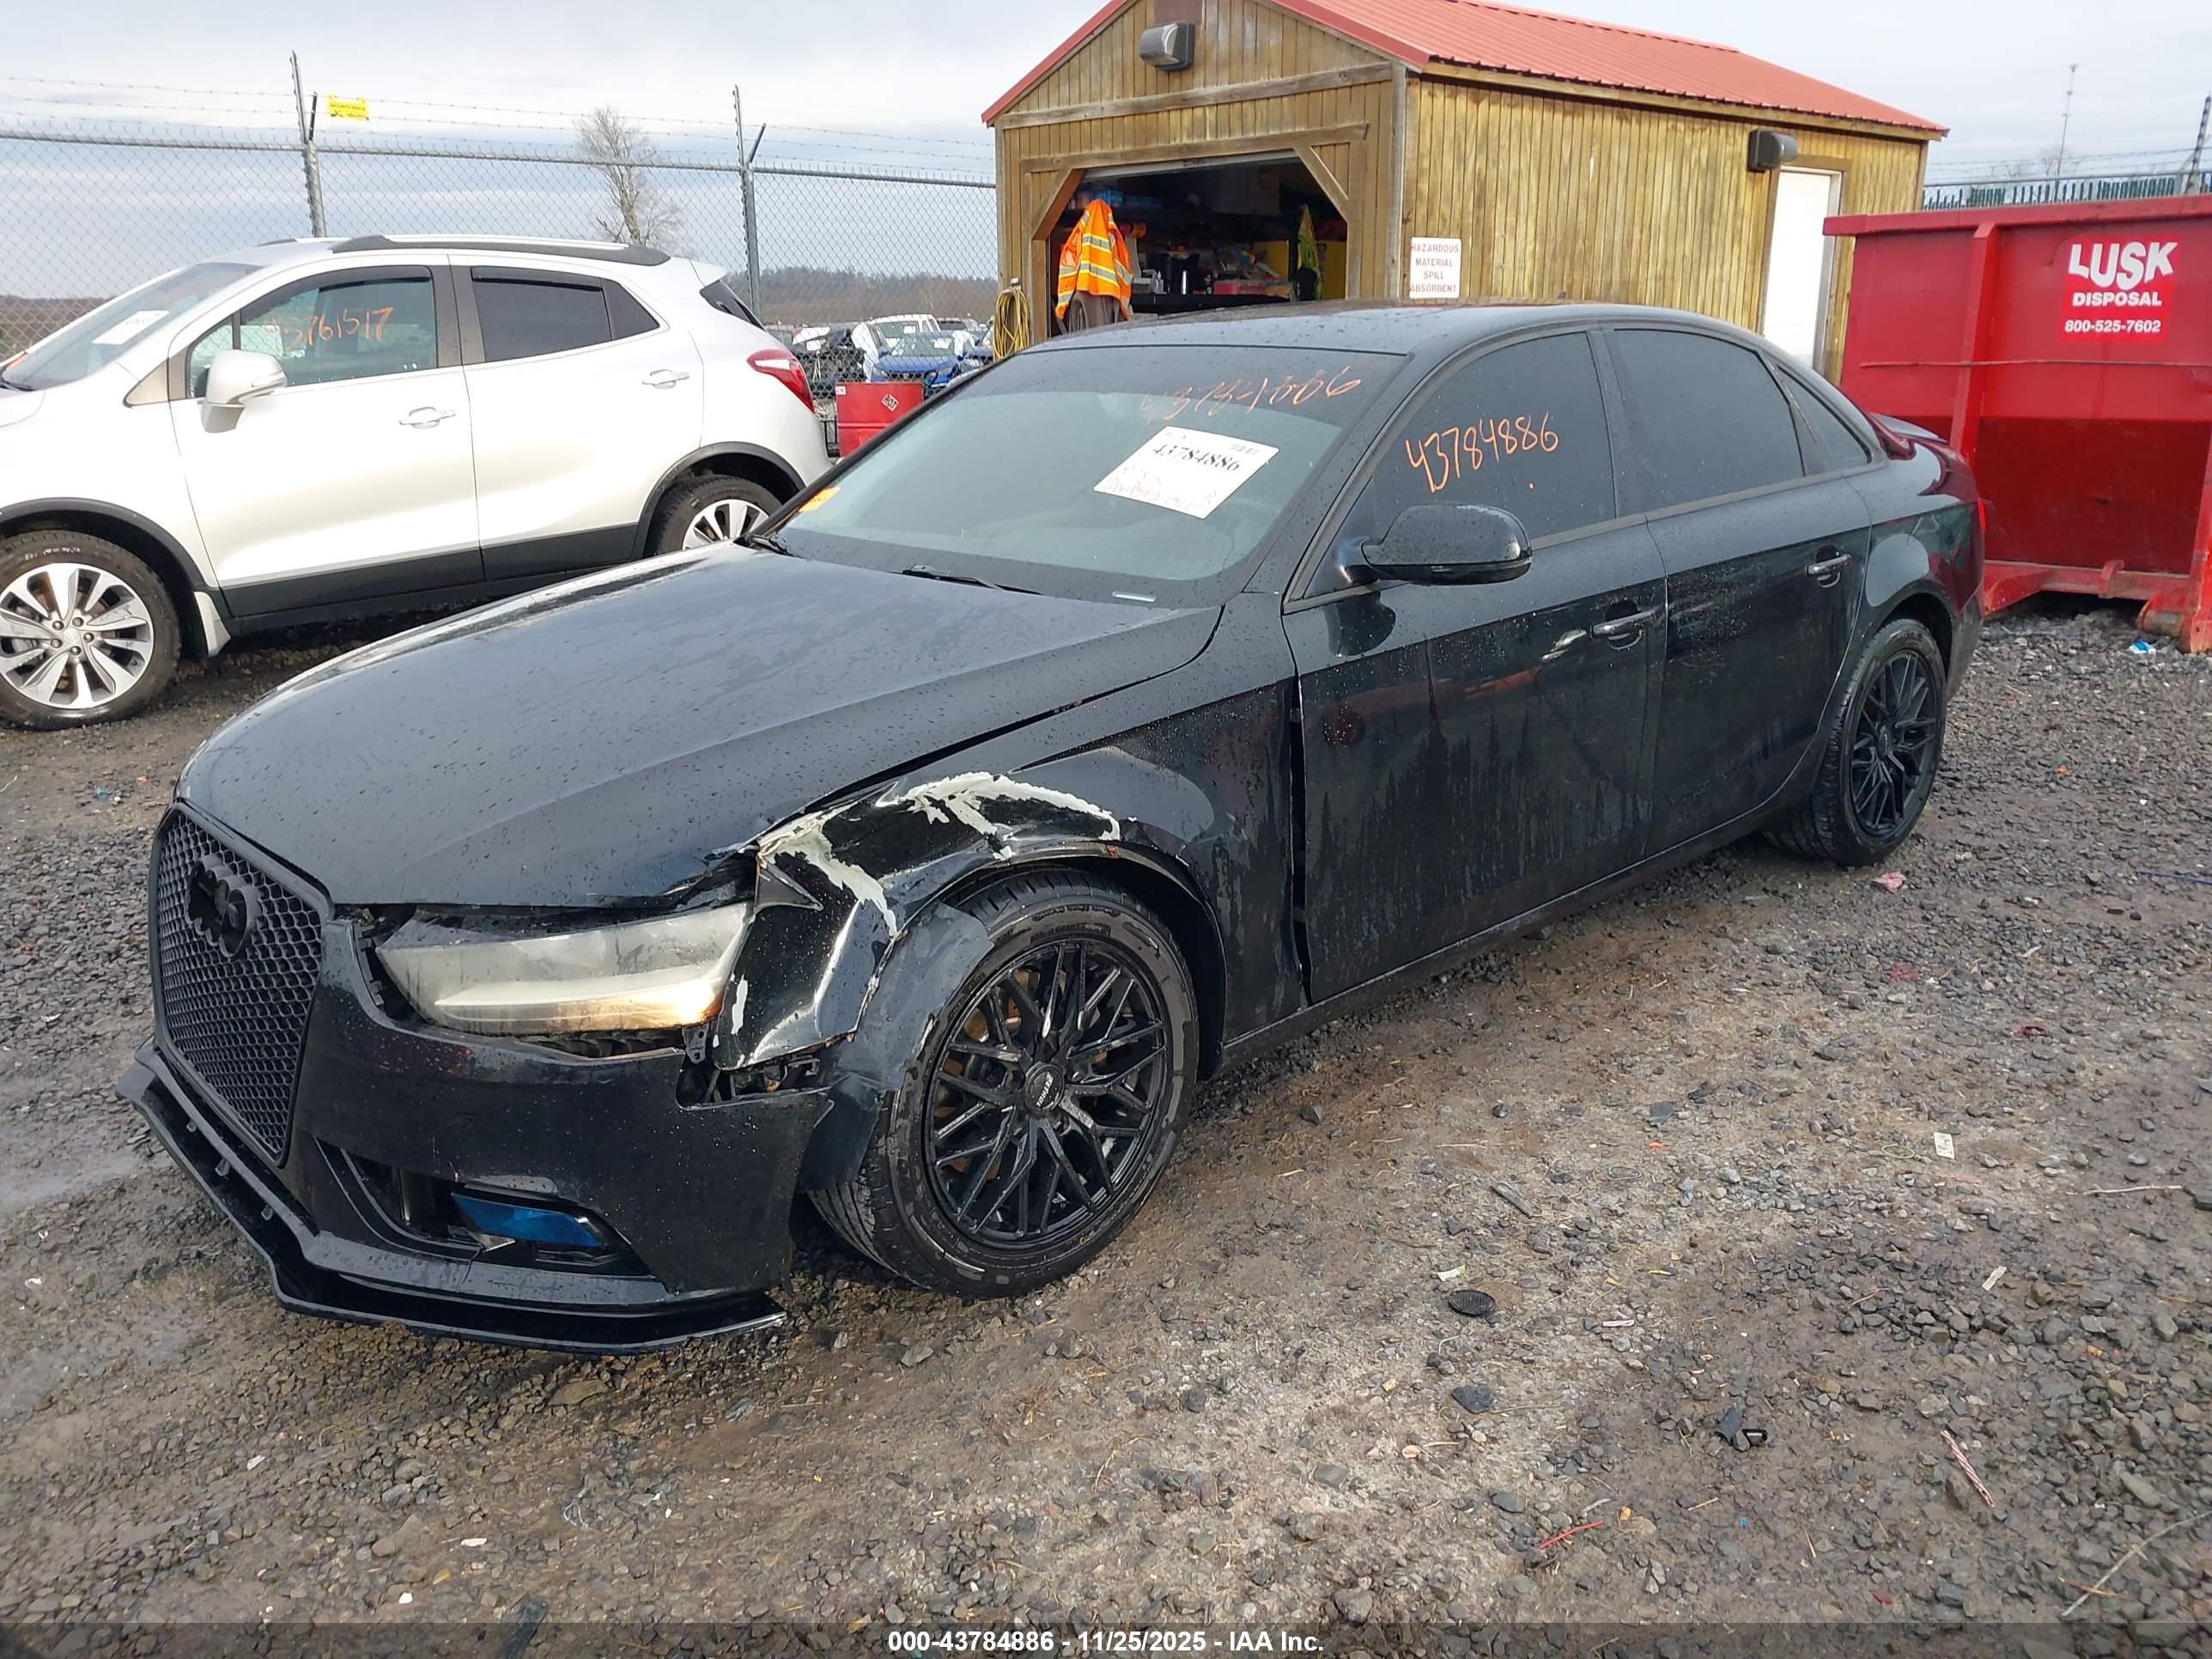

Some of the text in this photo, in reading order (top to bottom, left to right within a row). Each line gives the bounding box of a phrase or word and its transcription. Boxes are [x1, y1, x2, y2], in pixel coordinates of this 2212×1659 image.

[1411, 243, 1459, 253] HAZARDOUS
[1415, 258, 1453, 267] MATERIAL
[2069, 241, 2179, 290] LUSK
[1424, 270, 1444, 280] SPILL
[1410, 283, 1457, 293] ABSORBENT
[2072, 292, 2162, 307] DISPOSAL
[2064, 319, 2161, 333] 800-525-7602
[1152, 443, 1242, 471] 43784886
[1406, 412, 1559, 493] 43784886
